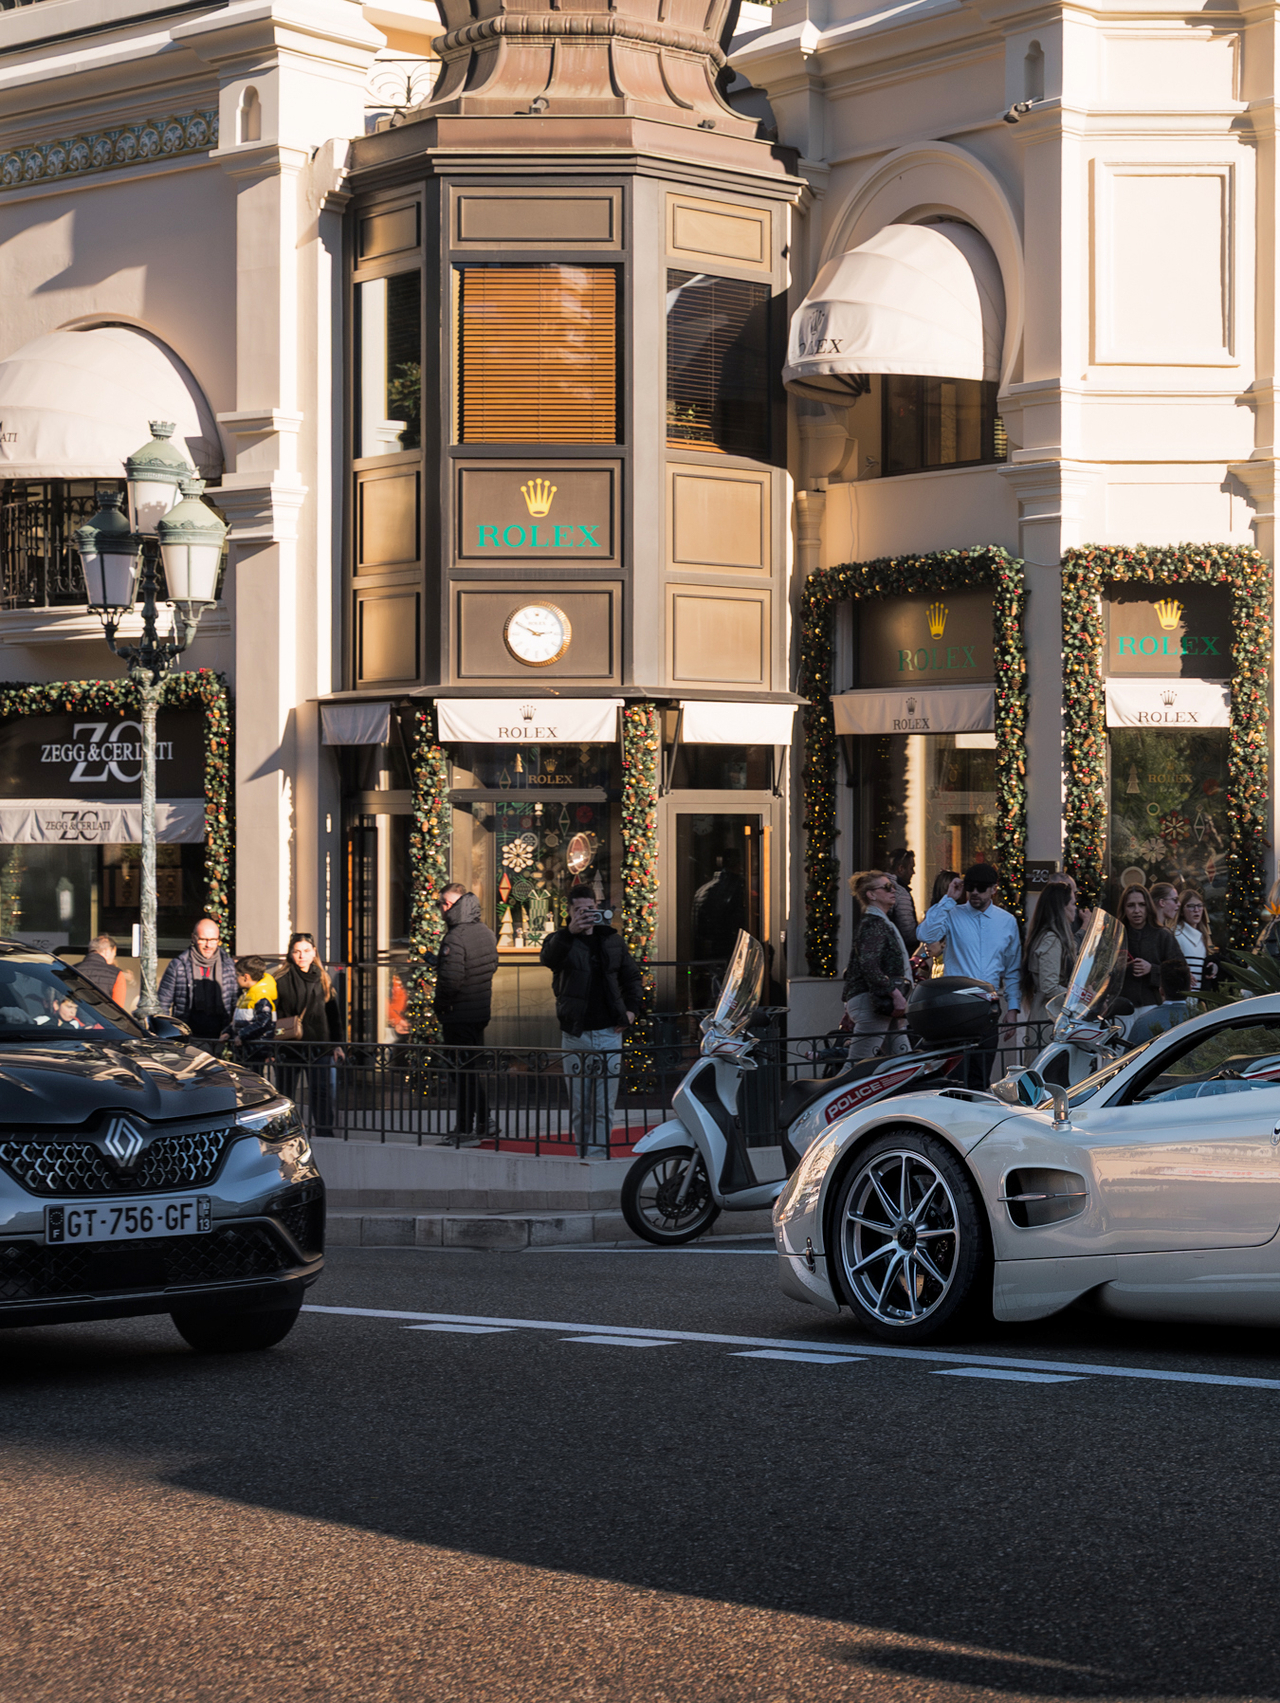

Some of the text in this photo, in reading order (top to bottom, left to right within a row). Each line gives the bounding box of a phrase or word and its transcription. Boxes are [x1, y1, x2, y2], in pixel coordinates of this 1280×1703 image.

[476, 524, 602, 548] ROLEX
[1116, 636, 1222, 656] ROLEX
[897, 646, 978, 672] ROLEX
[1138, 711, 1199, 723] ROLEX
[892, 718, 930, 731] ROLEX
[498, 727, 558, 739] ROLEX
[40, 744, 86, 763] ZEGG
[100, 741, 174, 761] CERLTI
[528, 774, 574, 785] ROLEX
[1148, 774, 1194, 784] ROLEX
[827, 1081, 883, 1119] POLICE
[67, 1203, 193, 1238] GT-756-GF
[199, 1218, 210, 1231] 13
[52, 1229, 61, 1239] F
